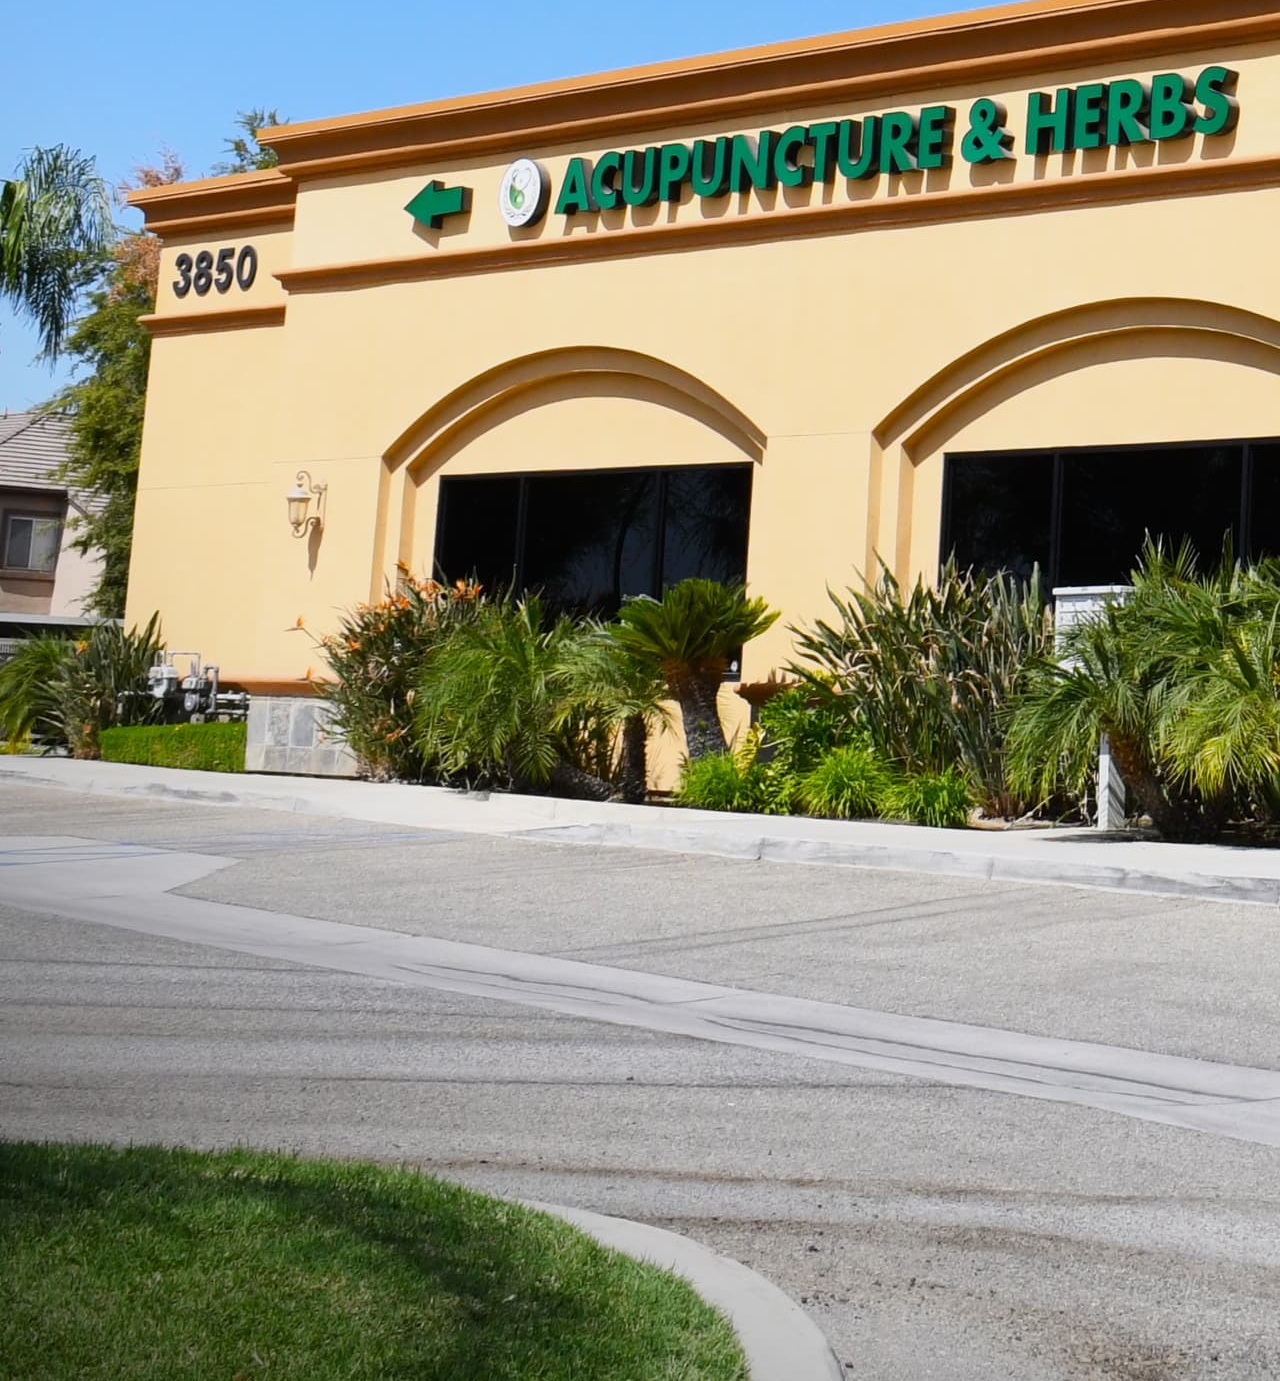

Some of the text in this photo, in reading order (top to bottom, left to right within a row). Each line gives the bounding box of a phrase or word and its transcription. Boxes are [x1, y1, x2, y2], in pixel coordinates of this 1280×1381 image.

[555, 66, 1233, 215] ACUPUNCTURE & HERBS
[172, 245, 258, 299] 3850
